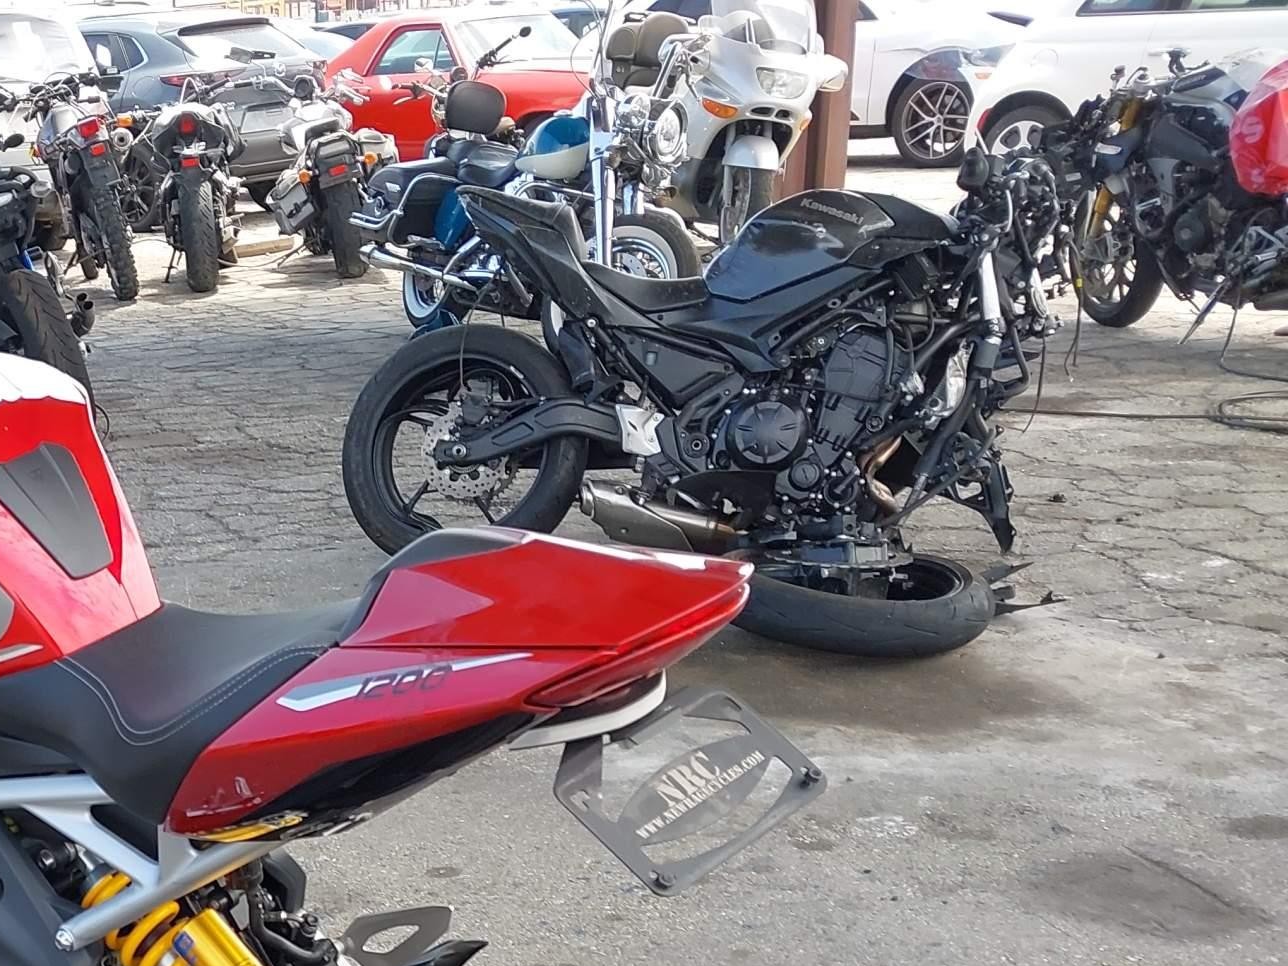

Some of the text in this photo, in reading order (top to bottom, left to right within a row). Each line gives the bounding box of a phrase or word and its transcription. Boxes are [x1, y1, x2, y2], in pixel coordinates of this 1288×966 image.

[799, 197, 865, 226] Kawasaki
[353, 662, 453, 699] 1200
[634, 749, 766, 840] WWW.NEWRAGECYCLES.COM
[656, 750, 721, 808] NRC
